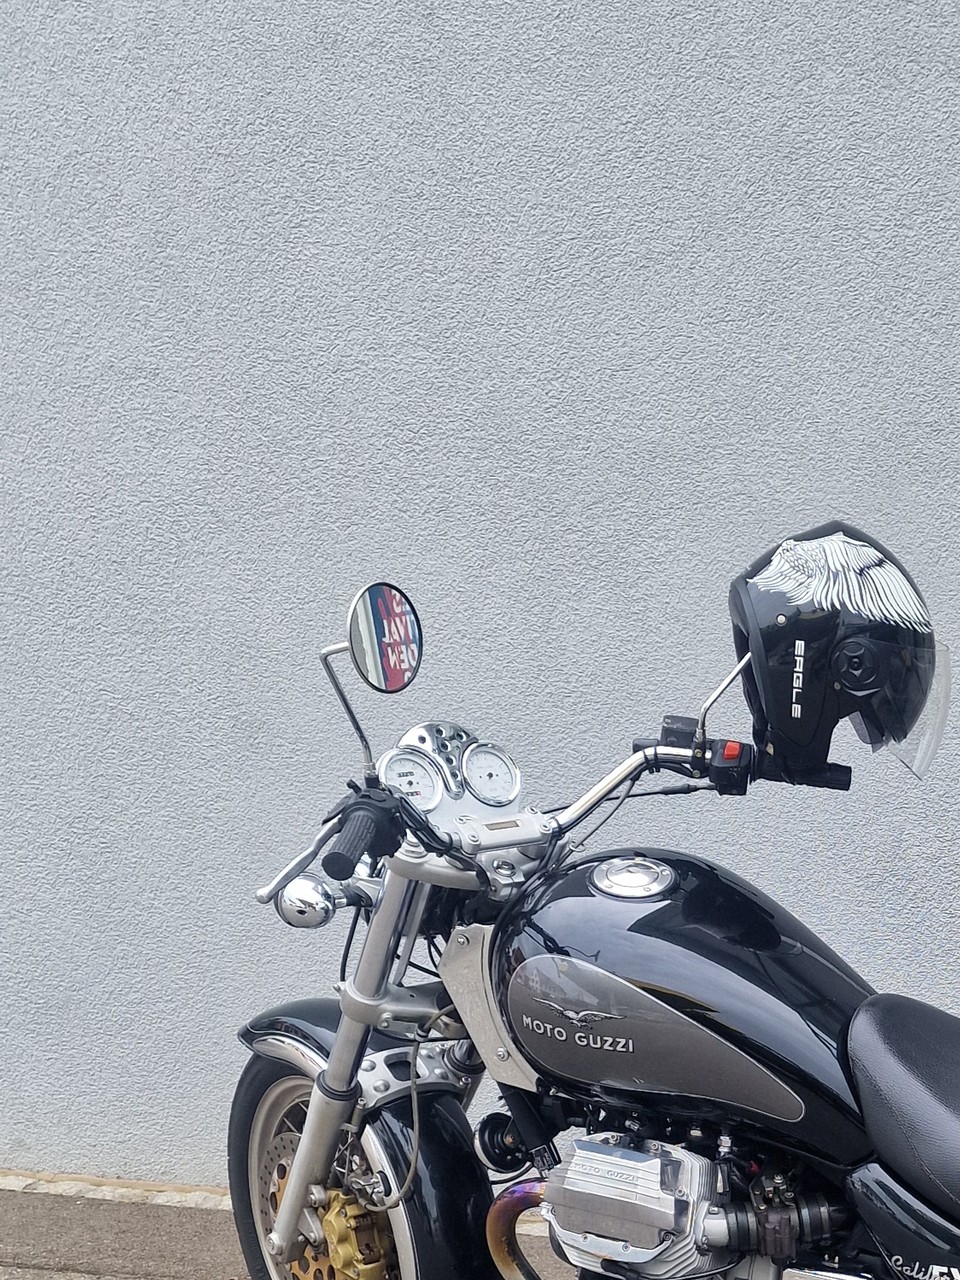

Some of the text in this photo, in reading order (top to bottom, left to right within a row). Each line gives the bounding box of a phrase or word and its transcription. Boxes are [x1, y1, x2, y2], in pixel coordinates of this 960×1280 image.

[791, 639, 805, 719] EAGLE
[522, 1014, 635, 1053] MOTO GUZZI
[606, 1169, 638, 1182] GUZZI
